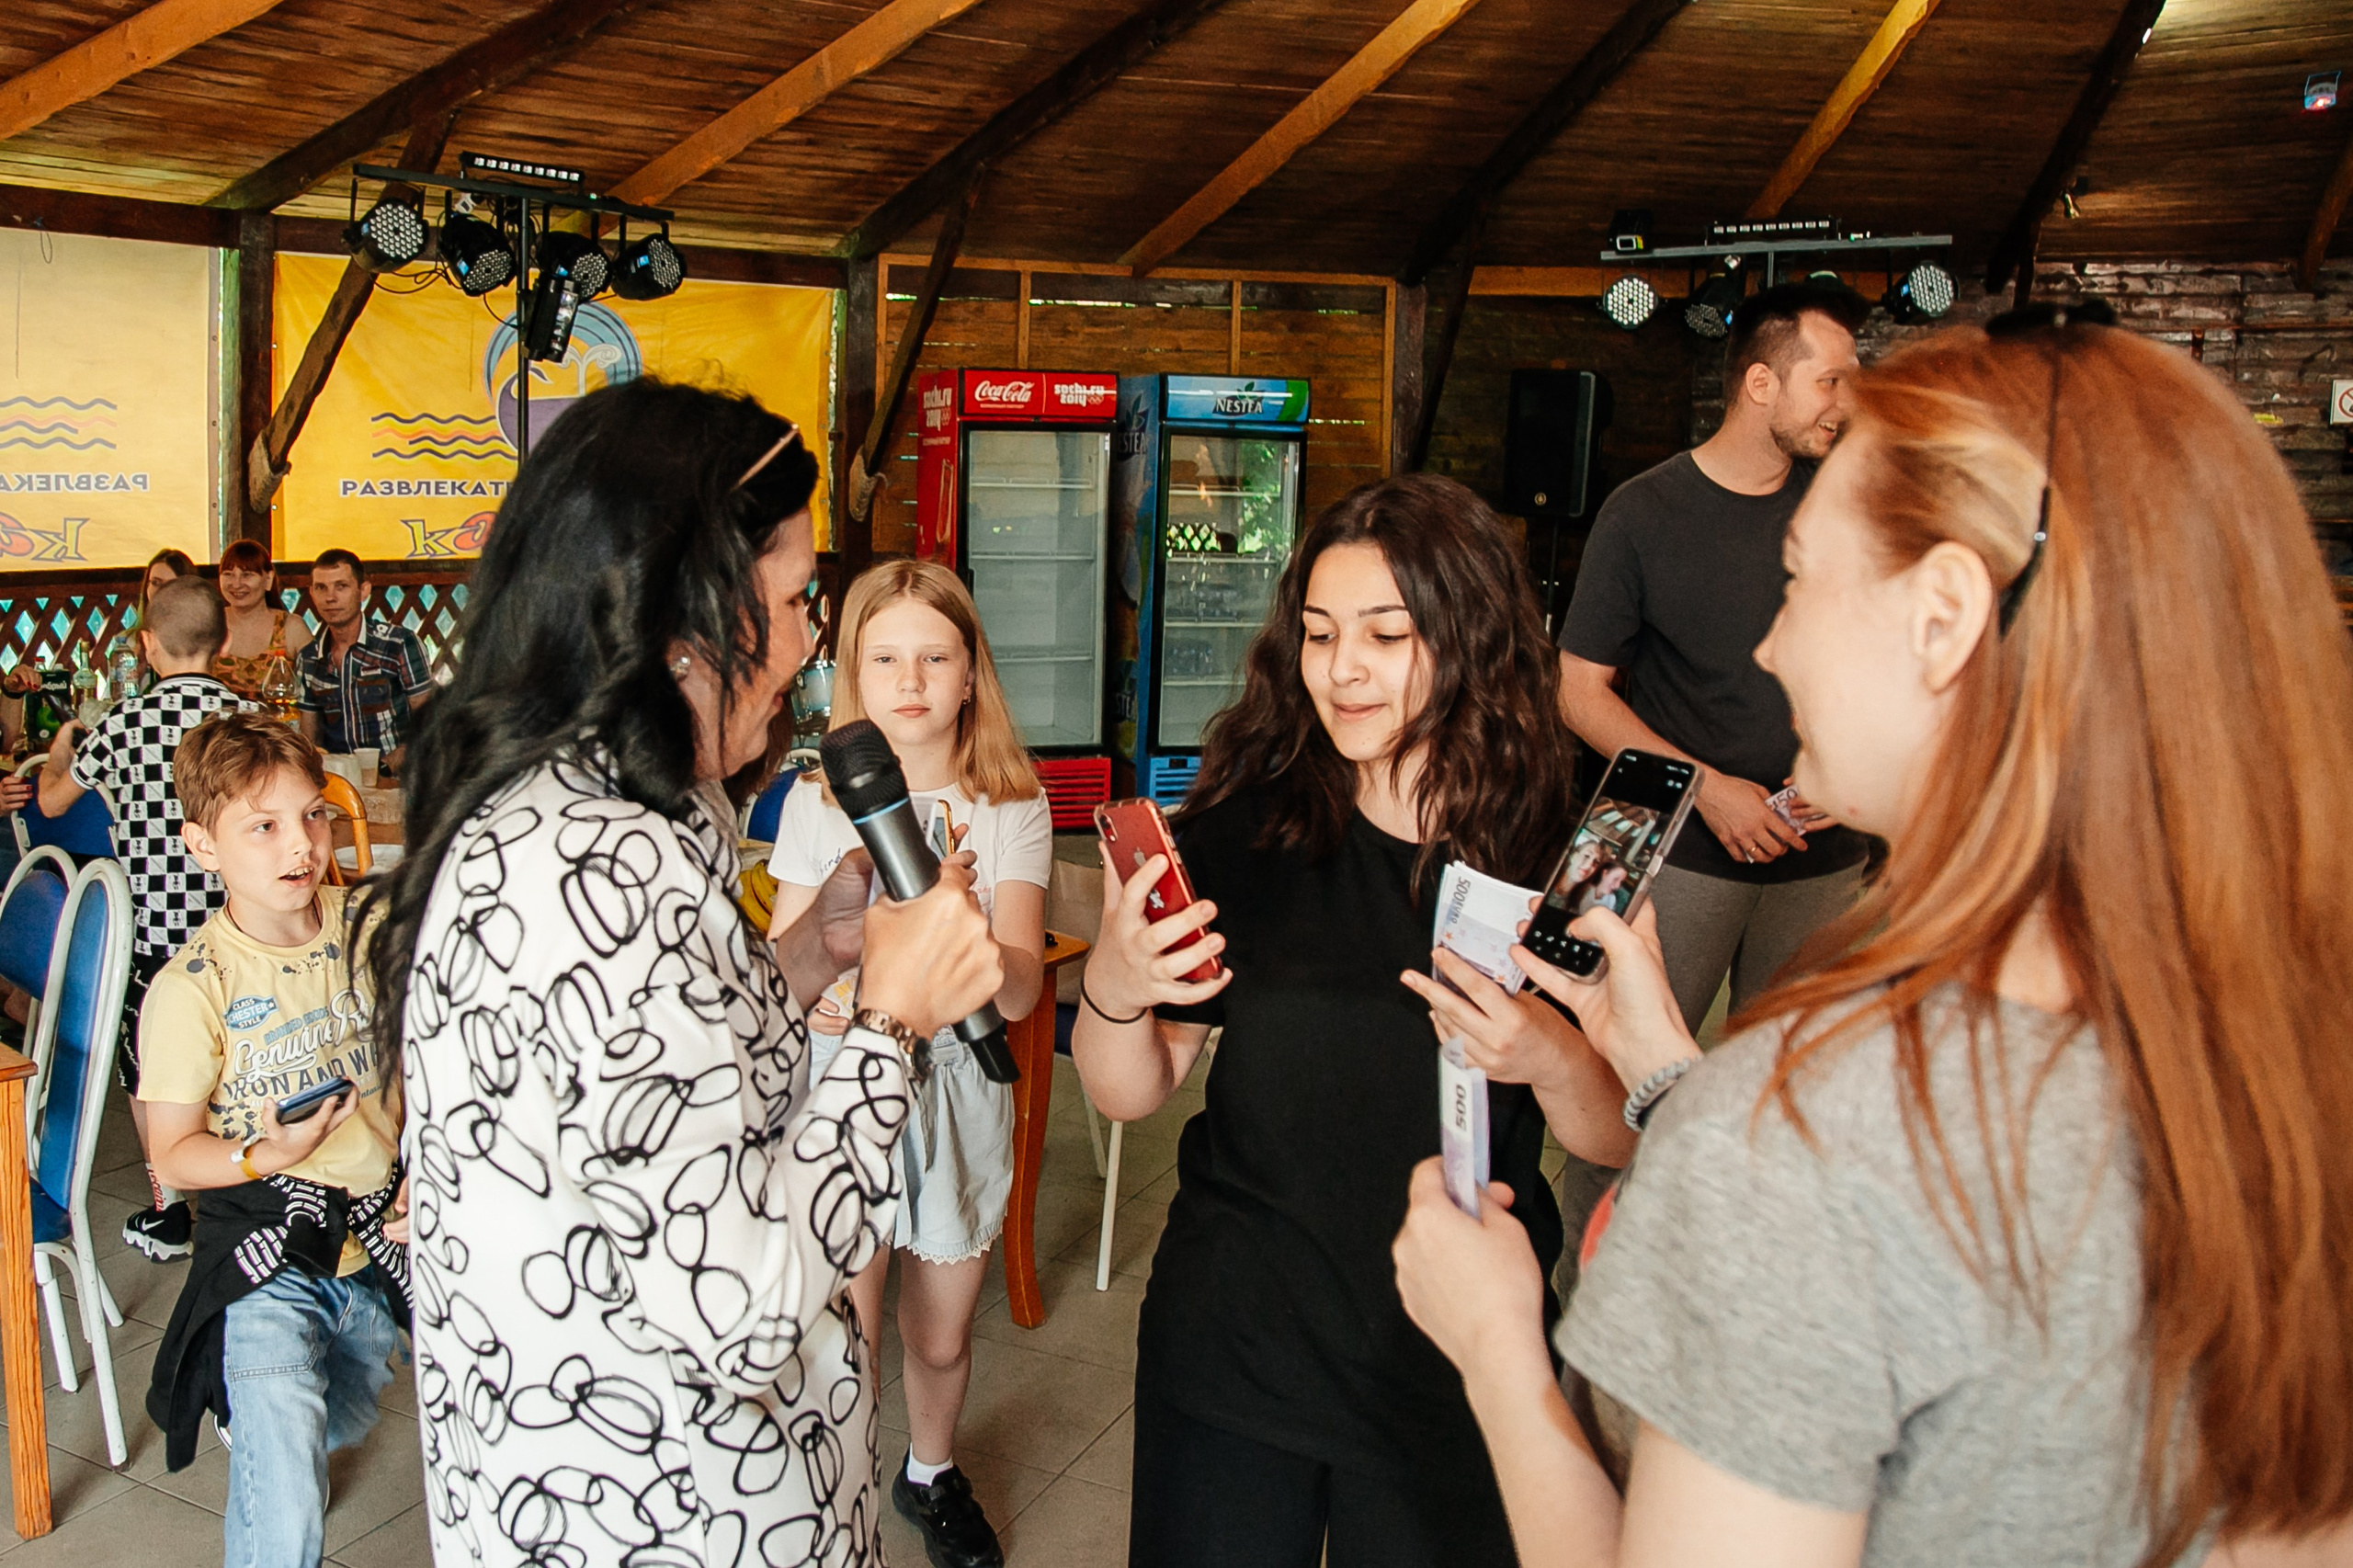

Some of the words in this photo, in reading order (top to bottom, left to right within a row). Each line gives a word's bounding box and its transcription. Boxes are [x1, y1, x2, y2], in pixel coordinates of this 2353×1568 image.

[974, 380, 1035, 403] Coca-Cola
[1215, 397, 1263, 414] NESTEA
[341, 480, 515, 496] РАЗВЛЕКАТ
[1453, 876, 1472, 903] 500
[233, 998, 256, 1010] CLASS
[238, 1016, 262, 1028] STYLE
[1455, 1084, 1468, 1132] 500
